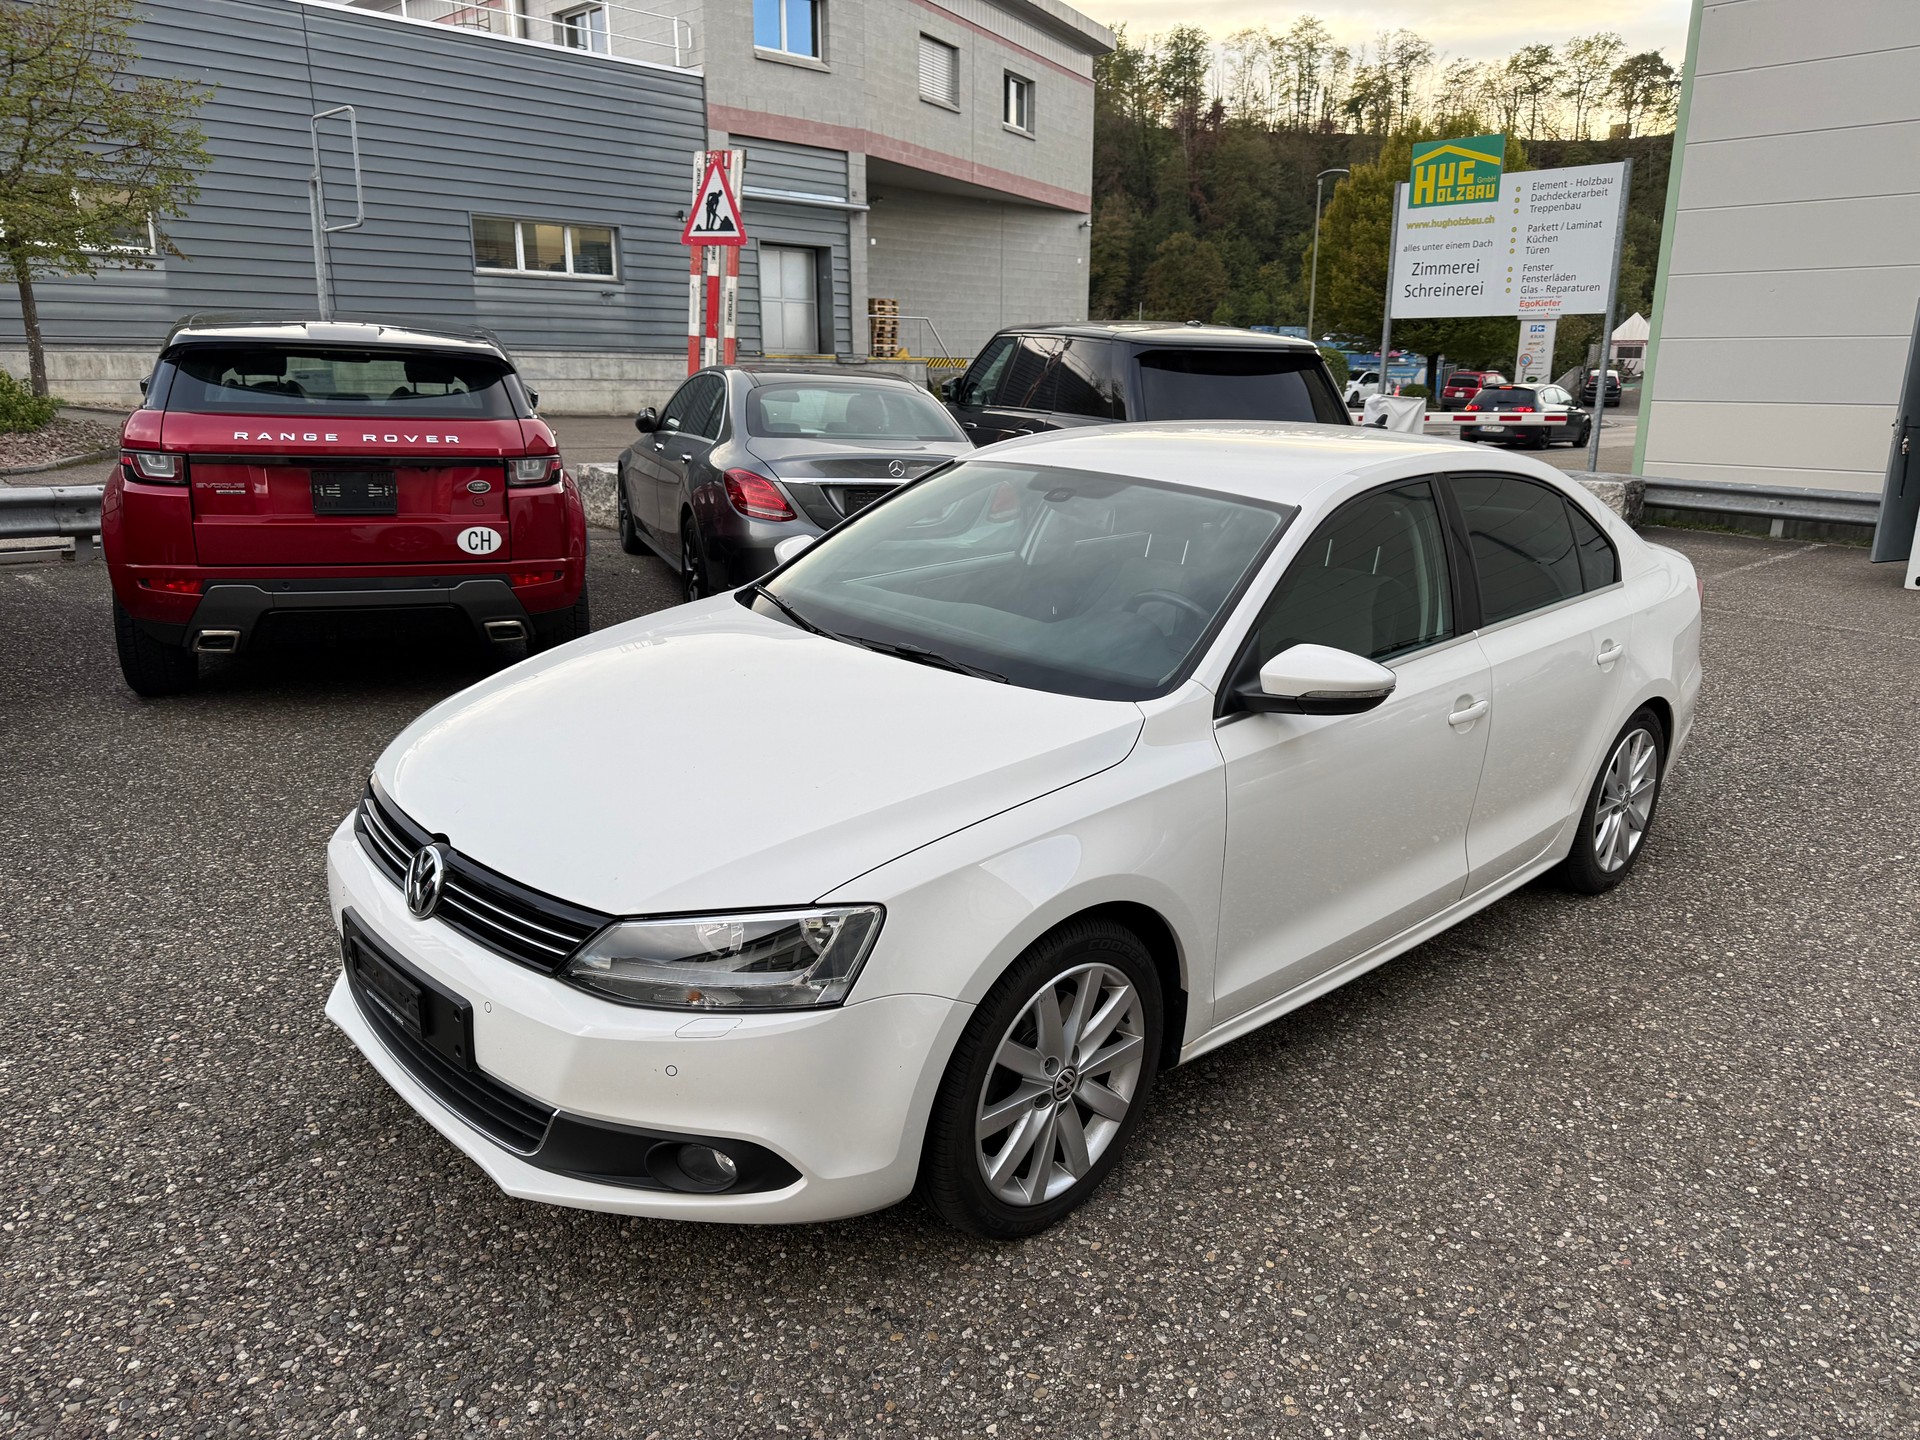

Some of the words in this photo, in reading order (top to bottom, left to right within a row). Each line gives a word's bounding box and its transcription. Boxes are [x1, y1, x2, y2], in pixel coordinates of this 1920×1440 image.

[1414, 160, 1475, 204] HUG
[1532, 180, 1568, 191] Element
[1576, 176, 1613, 187] Holzbau
[1530, 187, 1608, 202] Dachdeckerarbeit
[1530, 202, 1582, 214] Treppenbau
[1406, 215, 1495, 230] www.hugholzbau.ch
[1527, 223, 1559, 232] Parkett
[1566, 220, 1602, 230] Laminat
[1526, 234, 1559, 244] Küchen
[1403, 244, 1421, 252] alles
[1422, 243, 1444, 251] unter
[1445, 241, 1470, 250] einem
[1472, 239, 1493, 248] Dach
[1525, 246, 1550, 255] Türen
[1411, 259, 1480, 276] Zimmerei
[1522, 264, 1554, 272] Fenster
[1521, 273, 1577, 283] Fensterläden
[1404, 281, 1484, 298] Schreinerei
[1520, 285, 1538, 294] Glas
[1545, 284, 1601, 294] Reparaturen
[1519, 300, 1562, 308] EgoKiefer
[234, 431, 339, 442] RANGE
[363, 434, 460, 443] ROVER
[468, 531, 492, 550] CH
